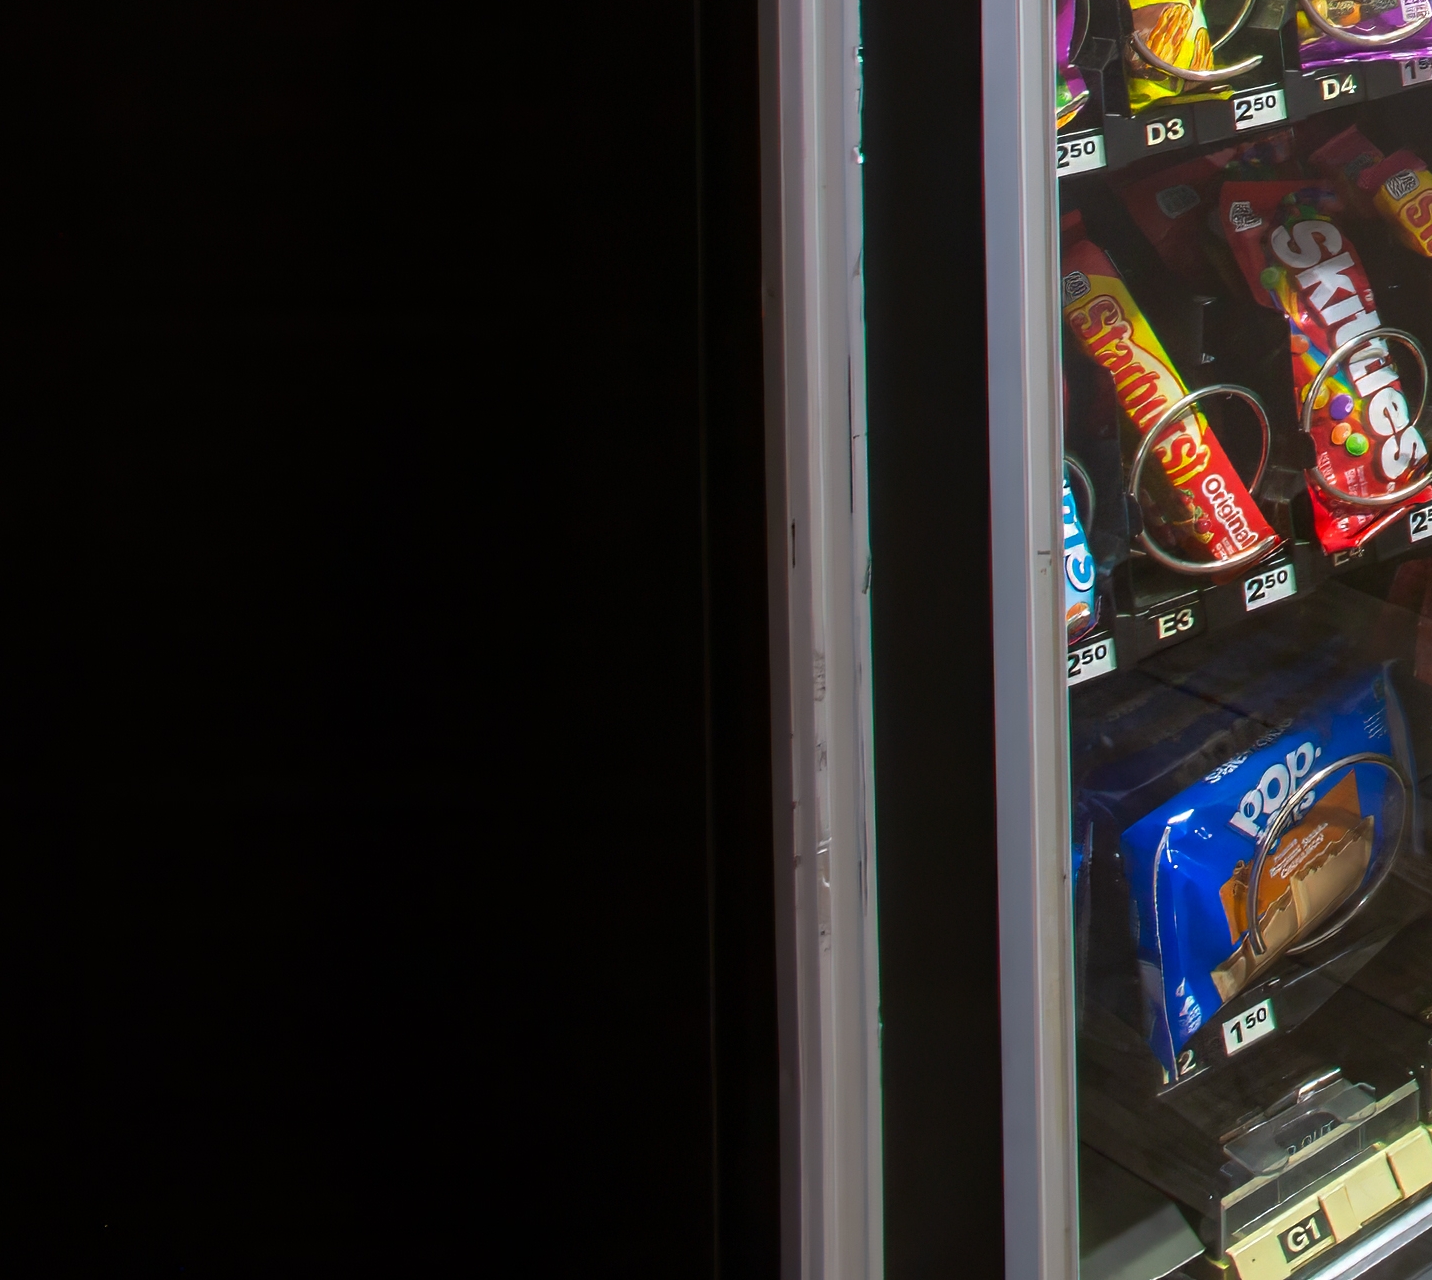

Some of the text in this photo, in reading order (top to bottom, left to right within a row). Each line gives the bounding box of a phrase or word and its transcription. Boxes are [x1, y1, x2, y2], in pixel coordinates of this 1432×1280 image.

[1321, 76, 1357, 101] D4
[1145, 96, 1277, 147] D3 250
[1271, 219, 1428, 481] Skittles
[1201, 474, 1257, 550] Original
[1158, 570, 1289, 639] E3 250
[1068, 643, 1108, 678] 250
[1230, 1007, 1268, 1046] 150
[1285, 1220, 1320, 1254] G1
